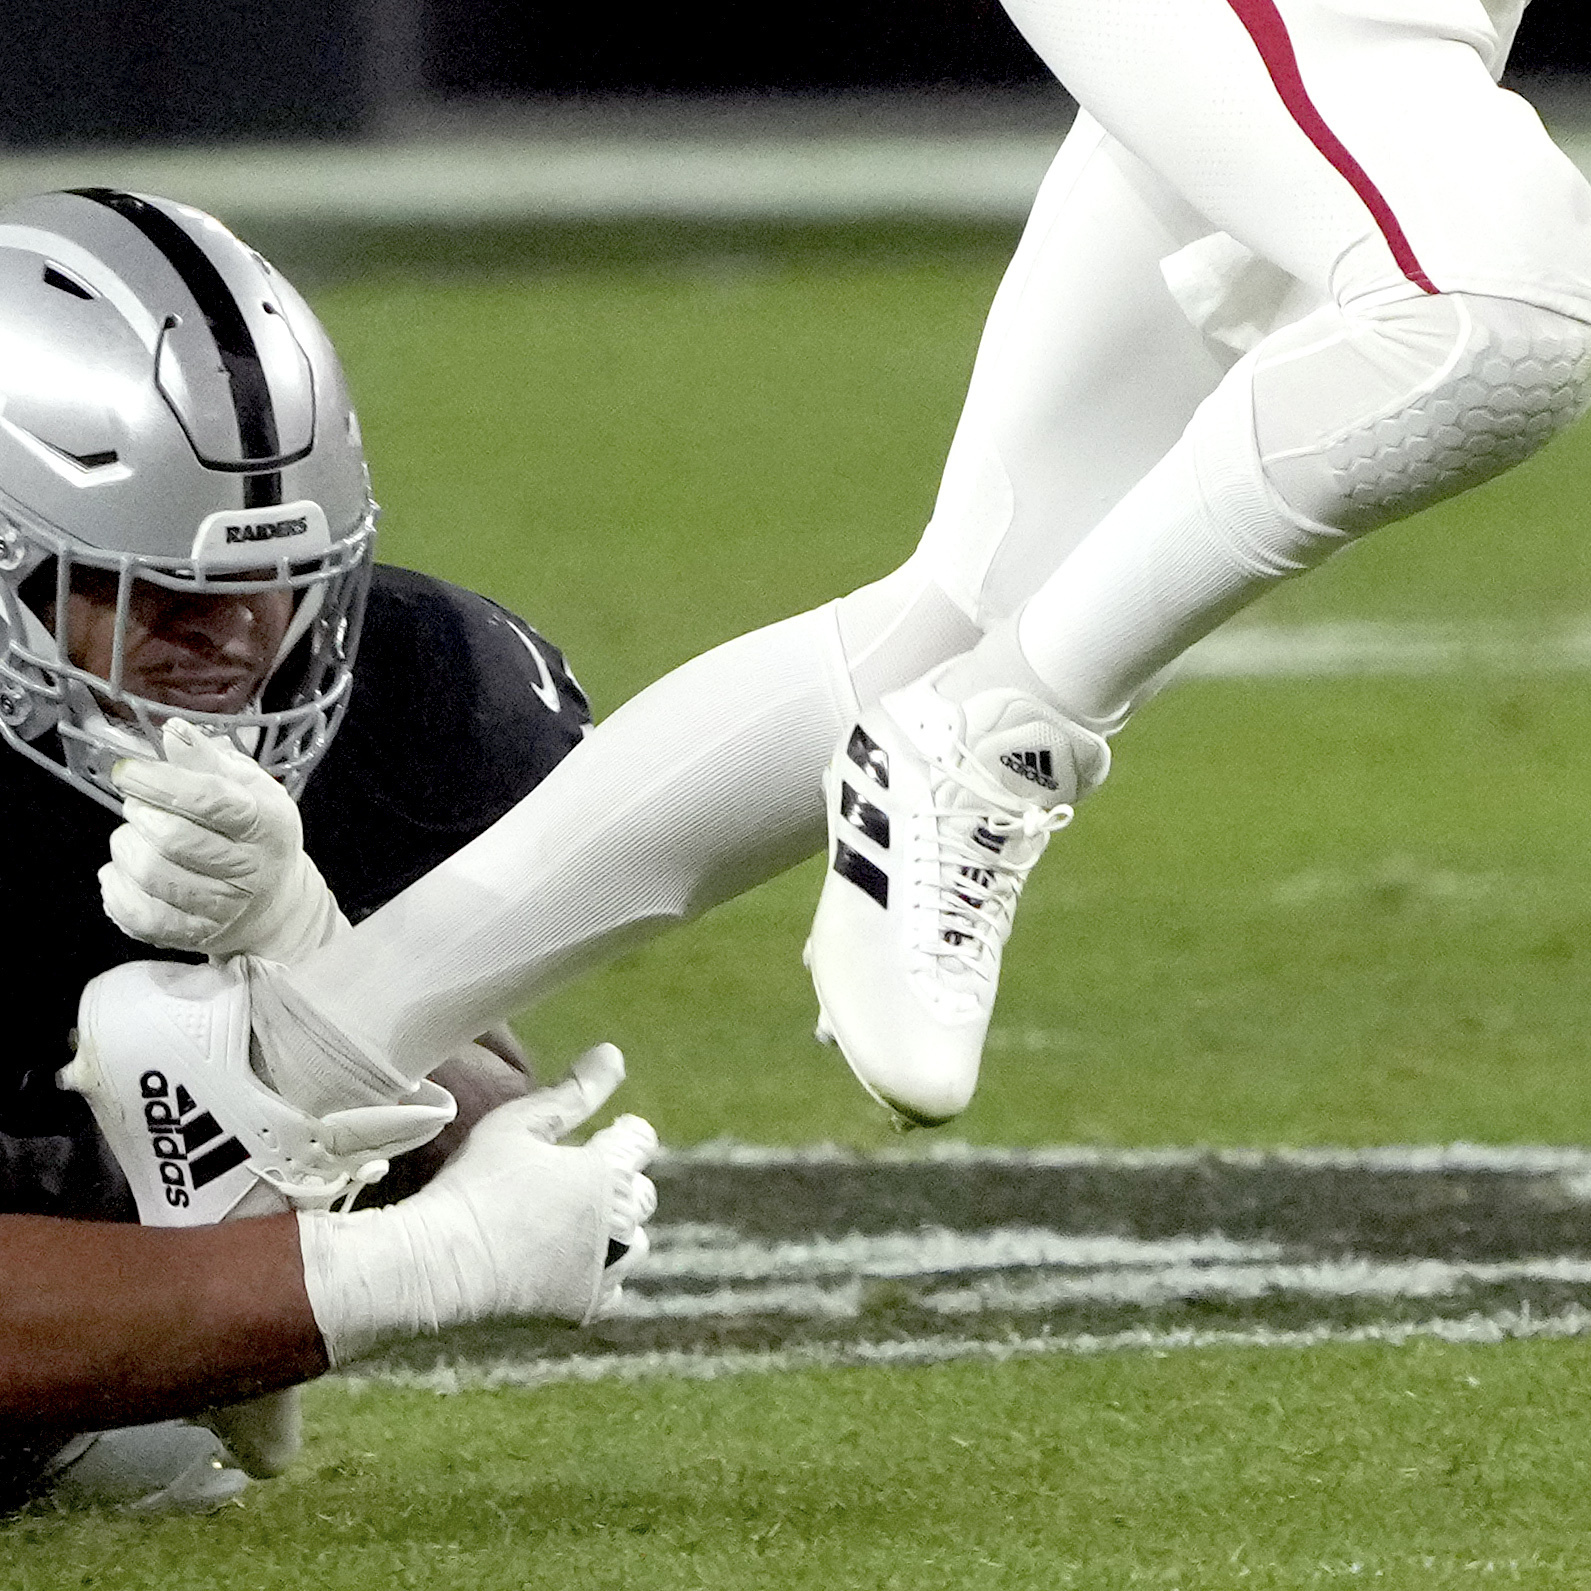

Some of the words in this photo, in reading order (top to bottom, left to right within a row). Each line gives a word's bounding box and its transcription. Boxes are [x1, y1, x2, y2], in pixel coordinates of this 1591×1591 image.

[226, 515, 308, 545] RAIDERS
[1000, 755, 1059, 792] adidas
[140, 1069, 190, 1208] adidas
